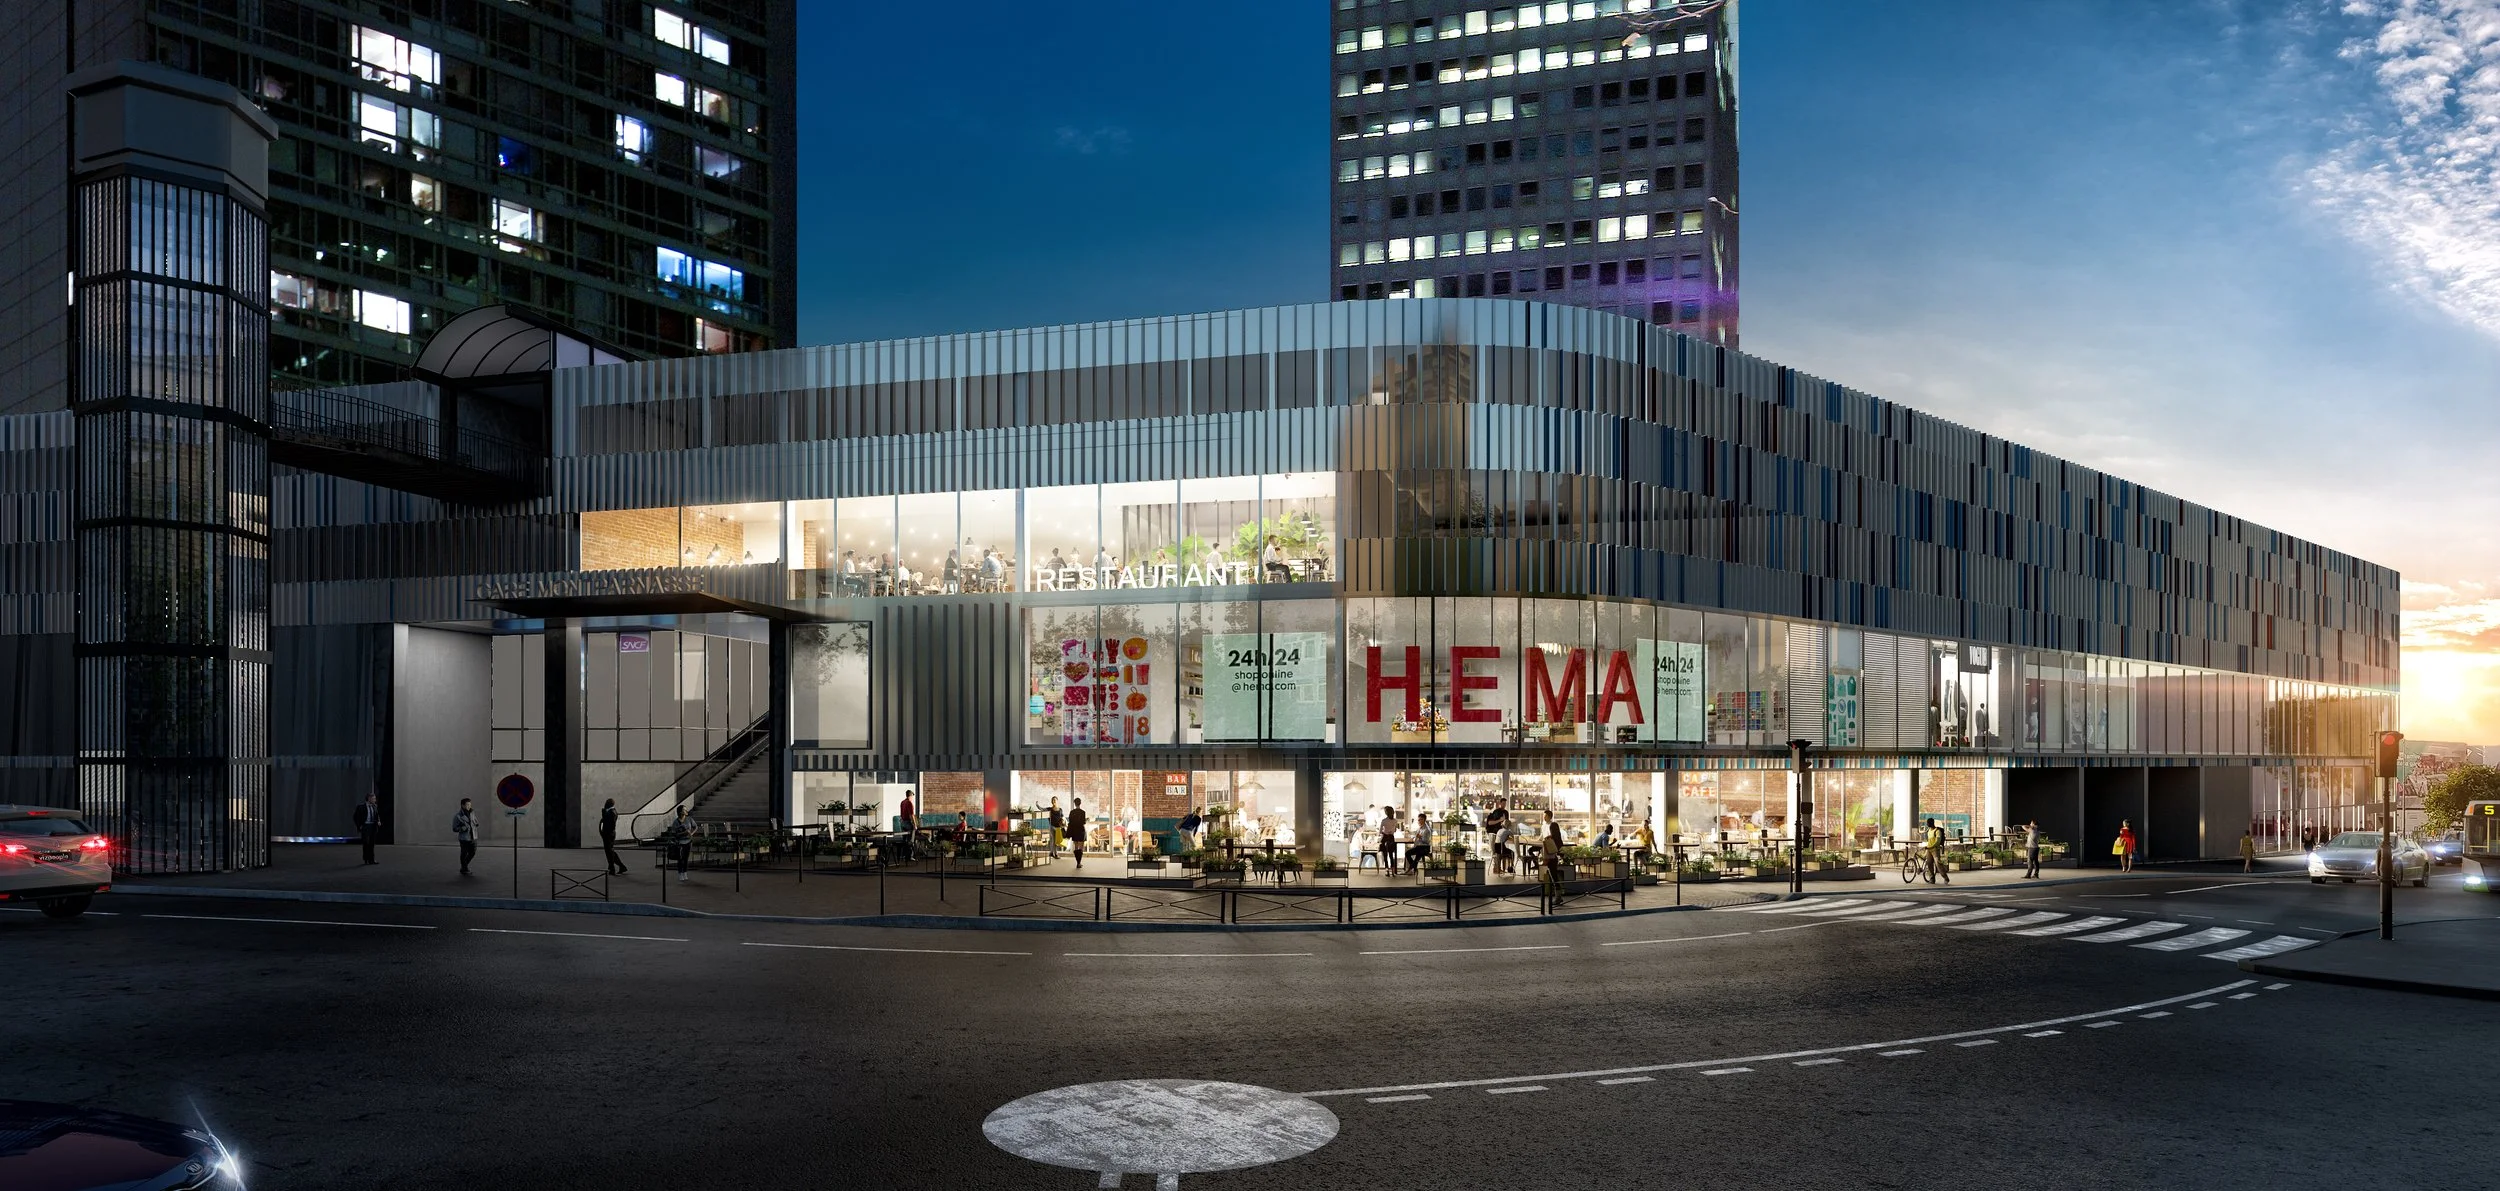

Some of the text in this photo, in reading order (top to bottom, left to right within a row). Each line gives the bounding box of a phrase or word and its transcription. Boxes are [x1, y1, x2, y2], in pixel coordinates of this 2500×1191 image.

[1036, 562, 1247, 592] RESTAURANT
[622, 641, 647, 650] SNCF
[1653, 656, 1694, 673] 24h24
[1235, 669, 1294, 681] shop oline
[1243, 682, 1297, 691] hemacom
[1366, 646, 1645, 724] HEMA
[1167, 775, 1186, 783] BAR
[1167, 786, 1186, 794] BAR
